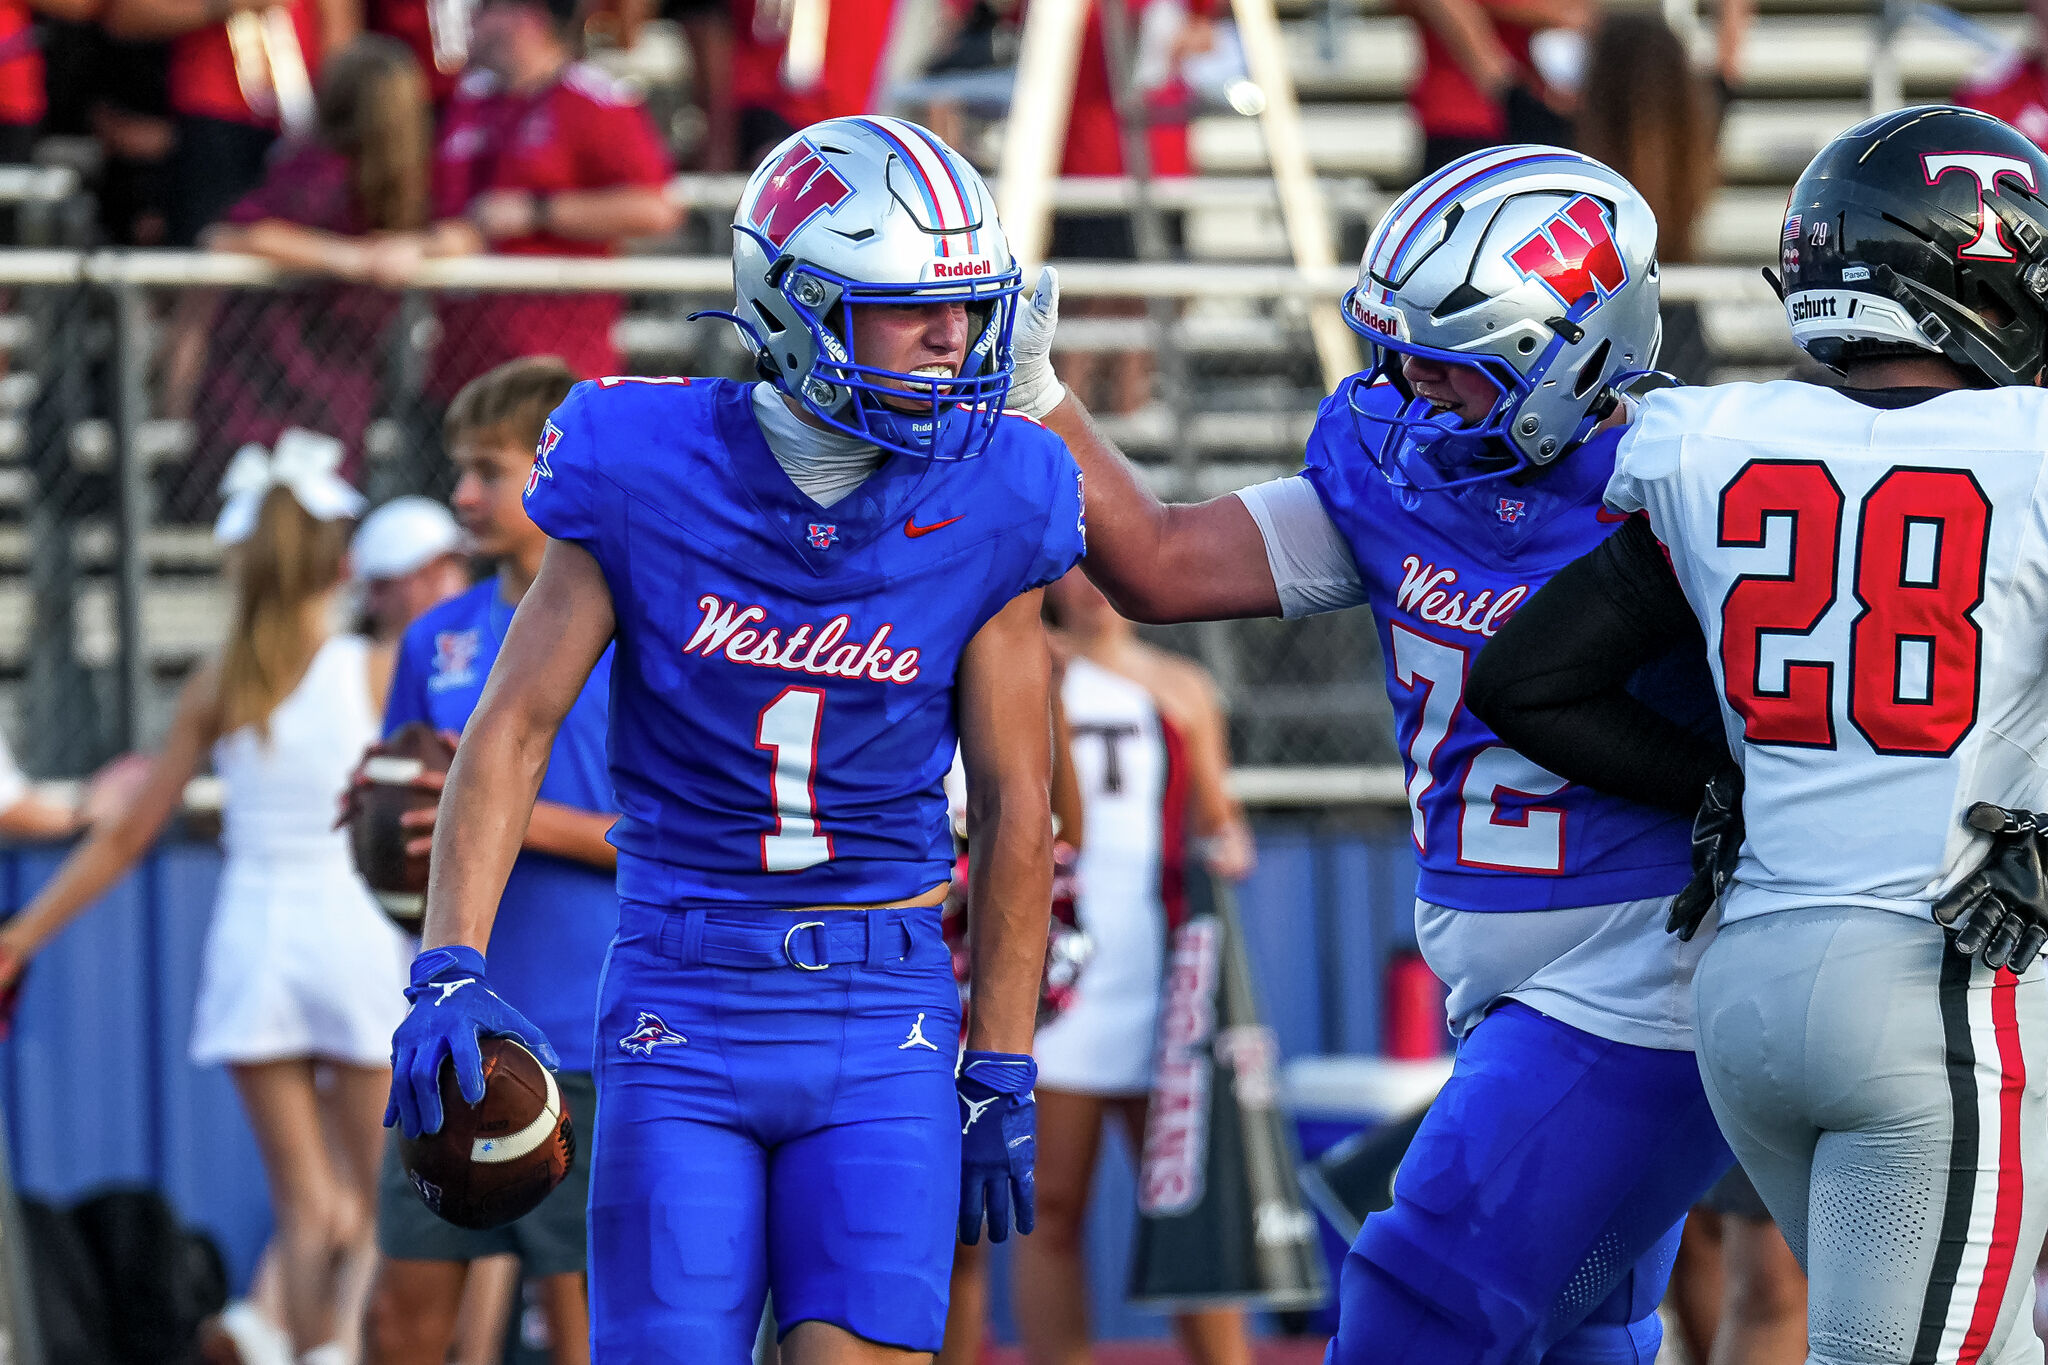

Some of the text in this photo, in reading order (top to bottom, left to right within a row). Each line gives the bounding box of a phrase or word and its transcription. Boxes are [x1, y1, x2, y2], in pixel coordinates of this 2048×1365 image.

[747, 135, 858, 255] W
[1811, 222, 1828, 246] 29
[1919, 150, 2039, 264] T
[933, 260, 991, 277] Riddell
[1502, 192, 1630, 324] W
[1354, 299, 1398, 337] Riddell
[1792, 294, 1837, 322] schutt
[683, 593, 921, 685] Westlake
[1396, 554, 1531, 638] Westl
[1716, 457, 1994, 759] 28
[755, 684, 835, 874] 1
[1069, 722, 1141, 794] T
[1389, 618, 1571, 876] 72
